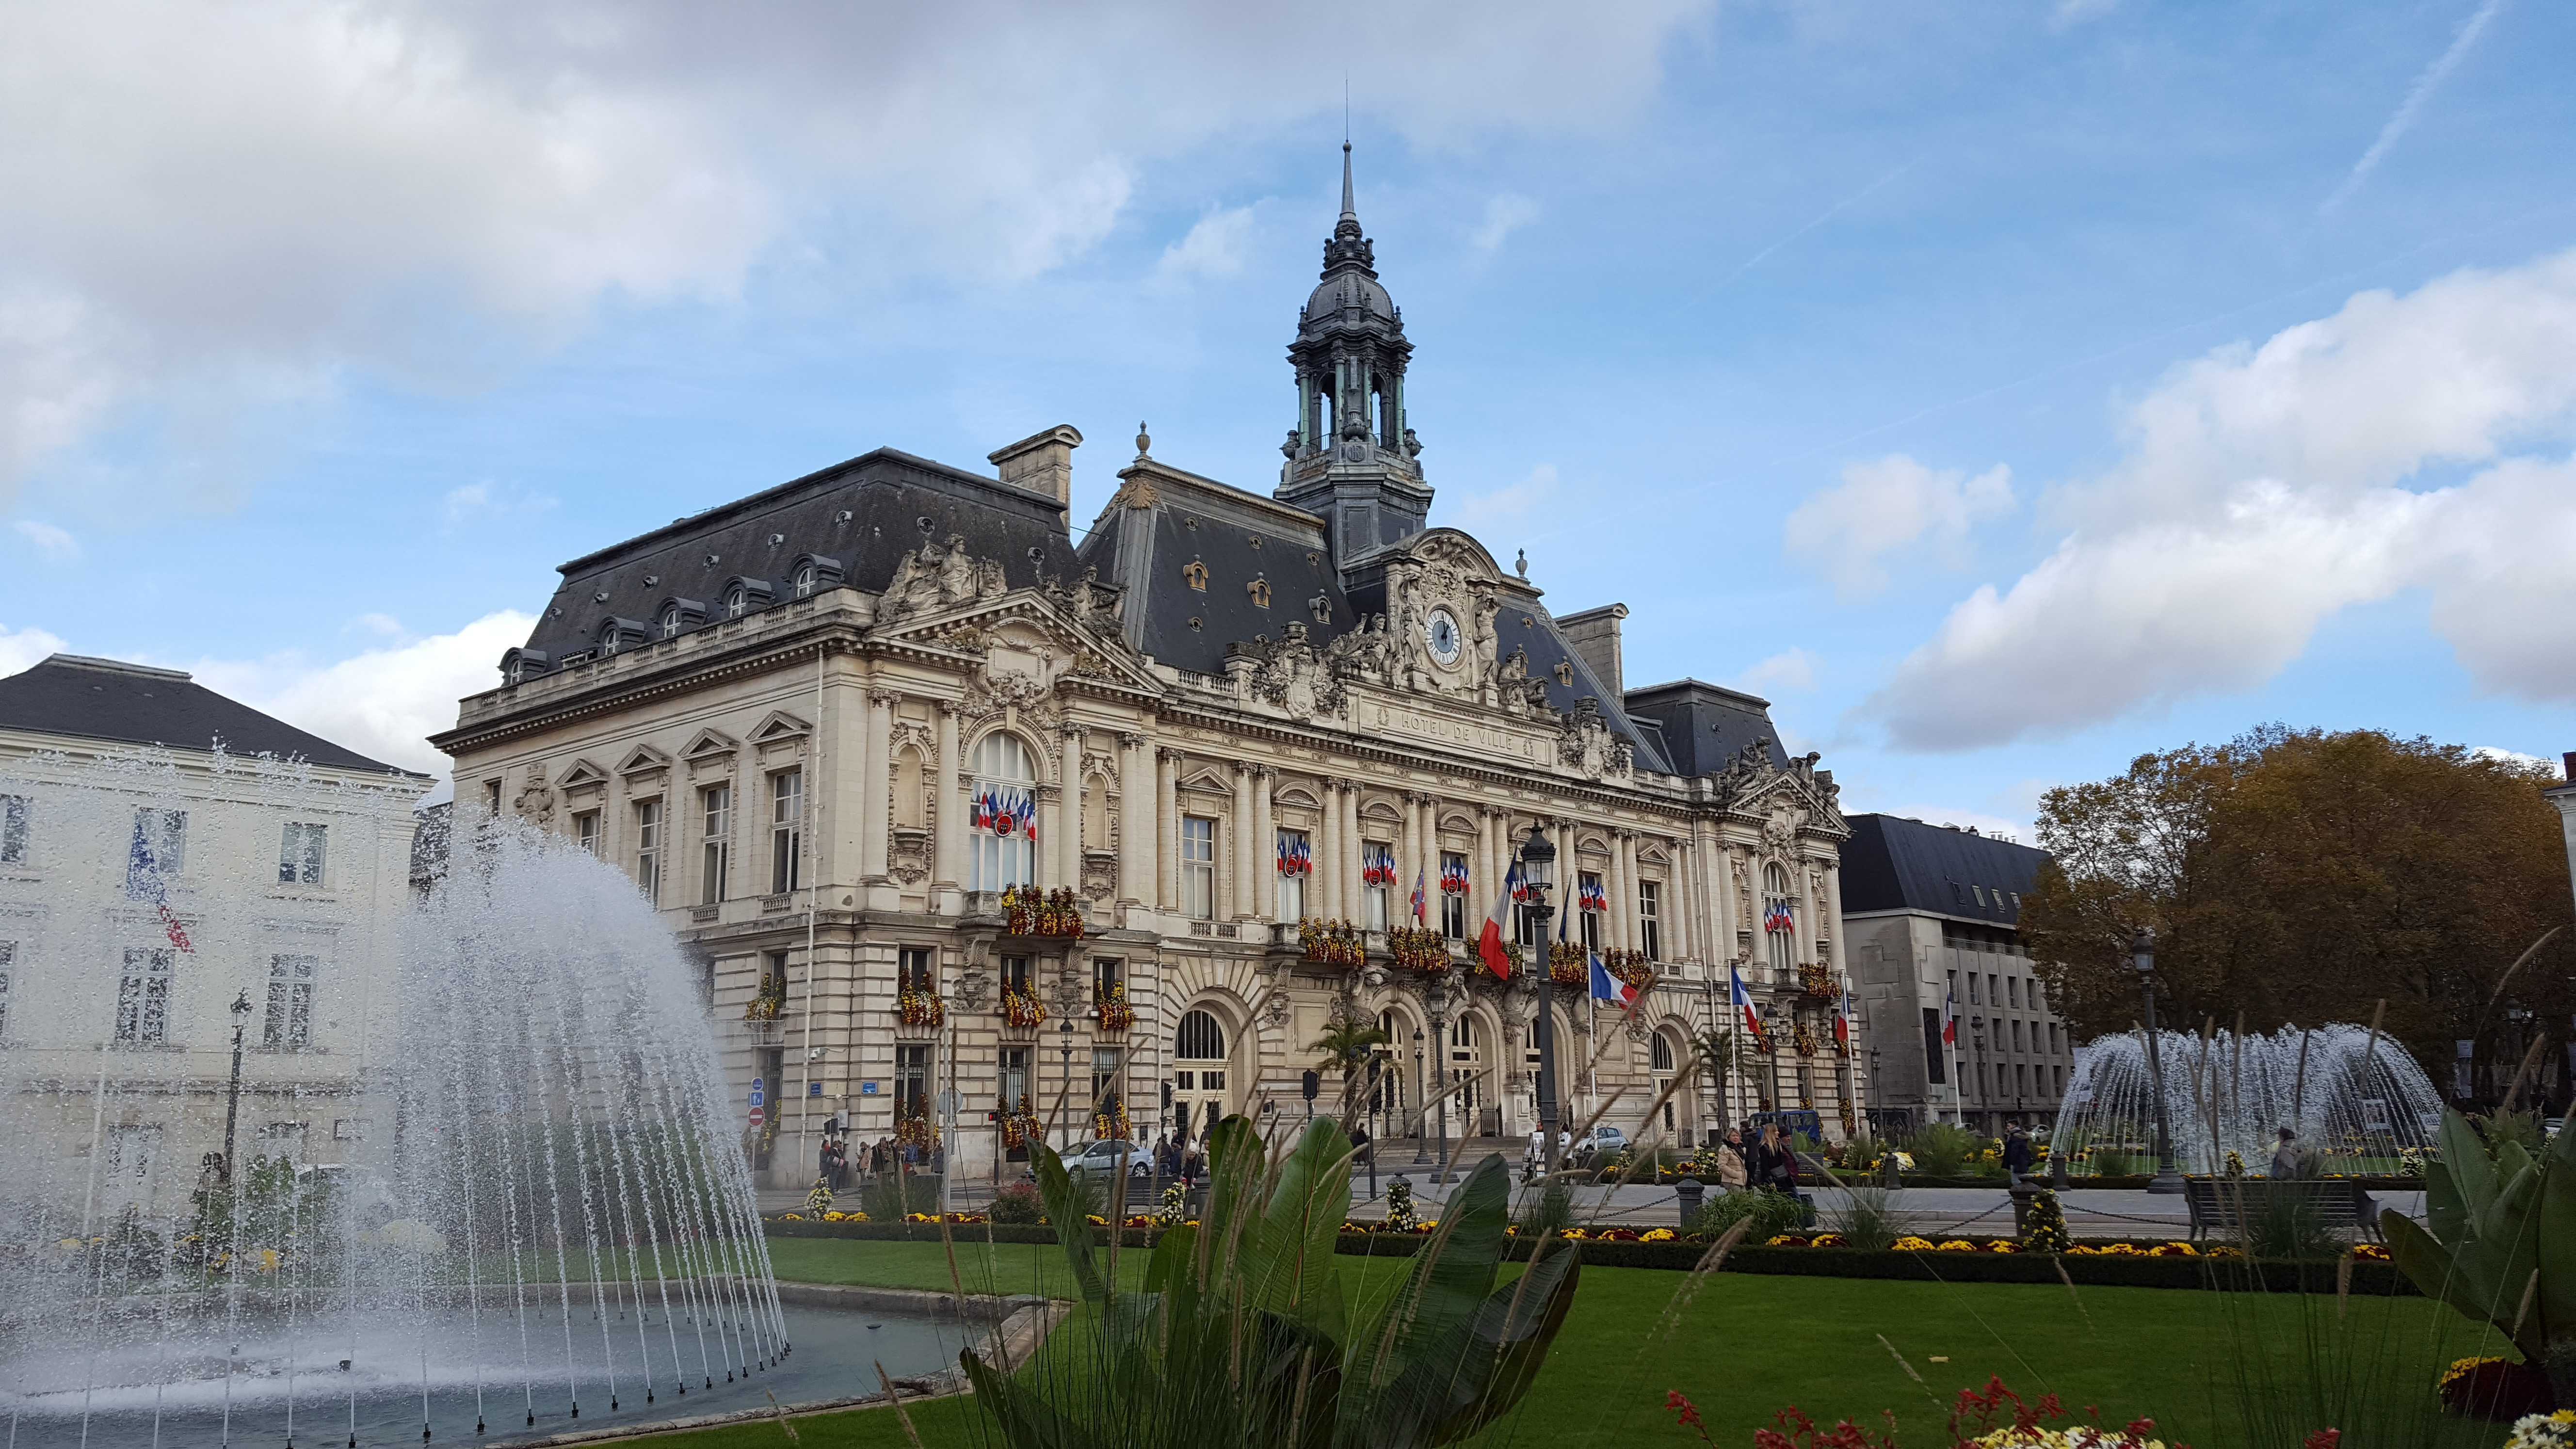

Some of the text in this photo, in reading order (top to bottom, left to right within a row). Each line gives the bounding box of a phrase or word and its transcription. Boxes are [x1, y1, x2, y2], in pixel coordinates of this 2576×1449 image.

[1402, 713, 1513, 749] HOTEL DE VILLE
